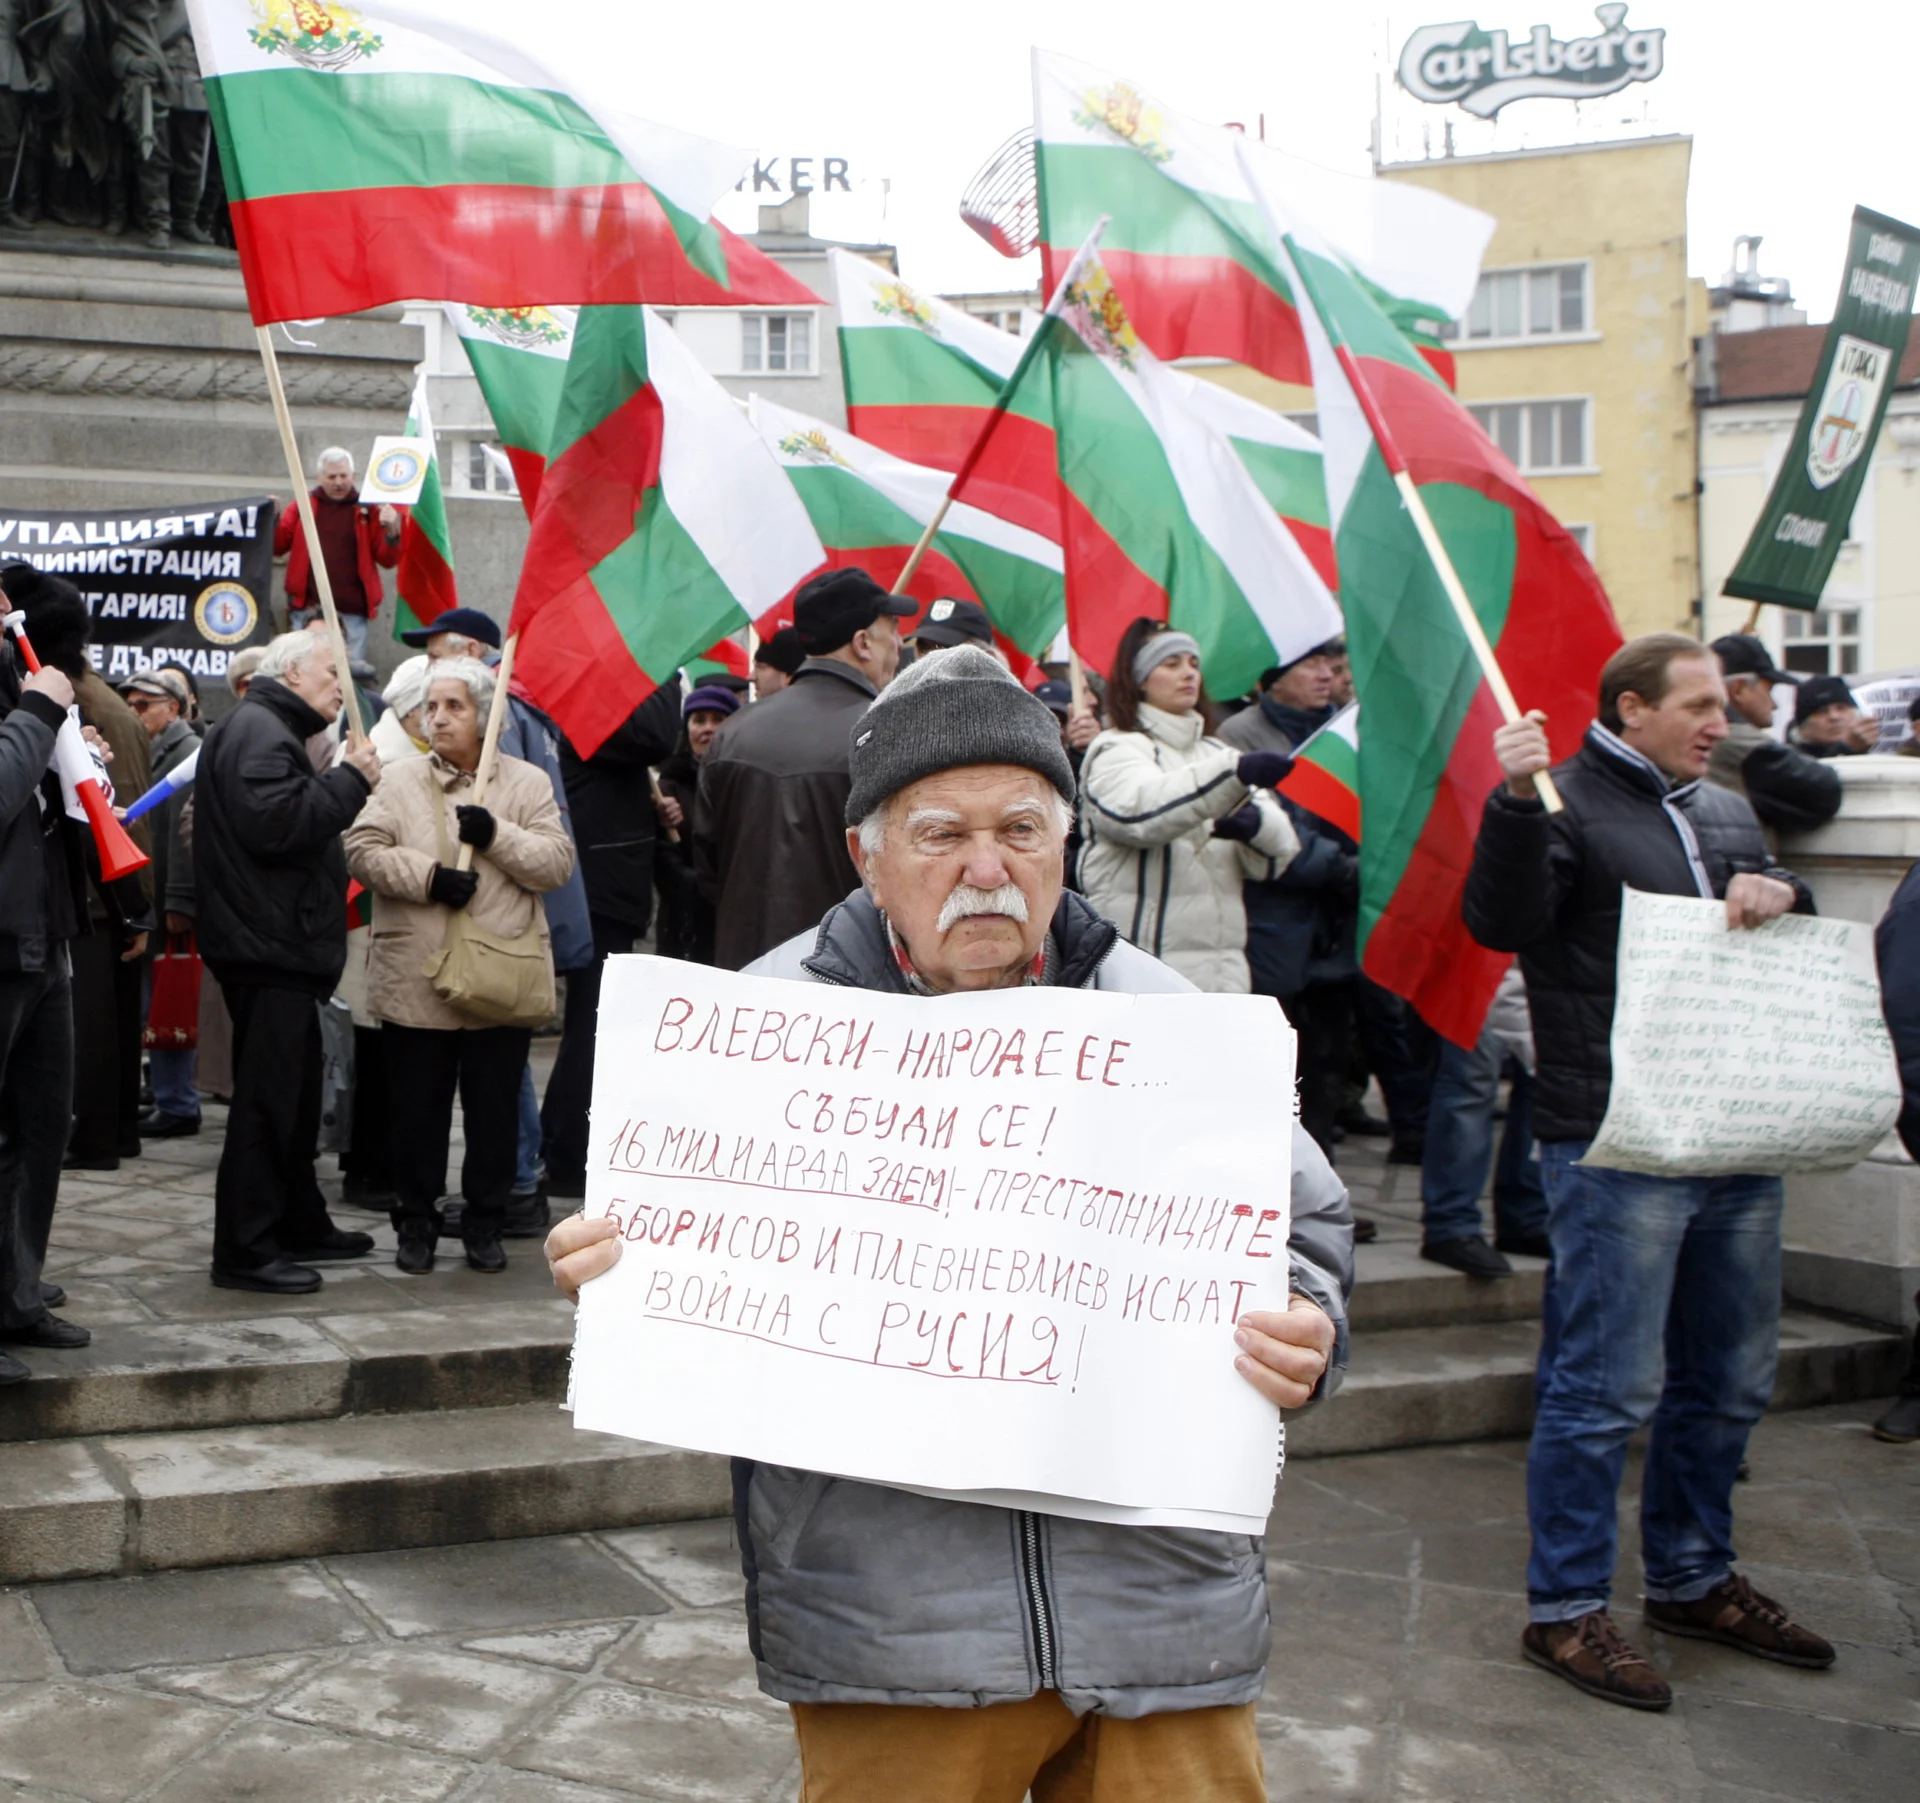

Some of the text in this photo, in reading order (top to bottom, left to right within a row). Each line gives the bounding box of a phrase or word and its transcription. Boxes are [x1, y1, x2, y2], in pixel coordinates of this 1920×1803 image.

[1399, 3, 1666, 104] Carlsberg
[735, 157, 852, 192] KER
[79, 592, 186, 620] ГАРИЯ!
[109, 645, 237, 677] ДЪРЖАВ
[785, 1089, 1057, 1157] СЪБУДИ СЕ!
[609, 1119, 648, 1168] 16
[974, 1168, 1281, 1258] ПРЕСТЪПНИЦИТЕ
[814, 1226, 843, 1274] И
[854, 1231, 1109, 1311] ПЛЕВНЕВЛИЕВ
[1122, 1273, 1257, 1326] ИСКАТ
[645, 1270, 1088, 1394] ВОЙНА С РУСИЯ!
